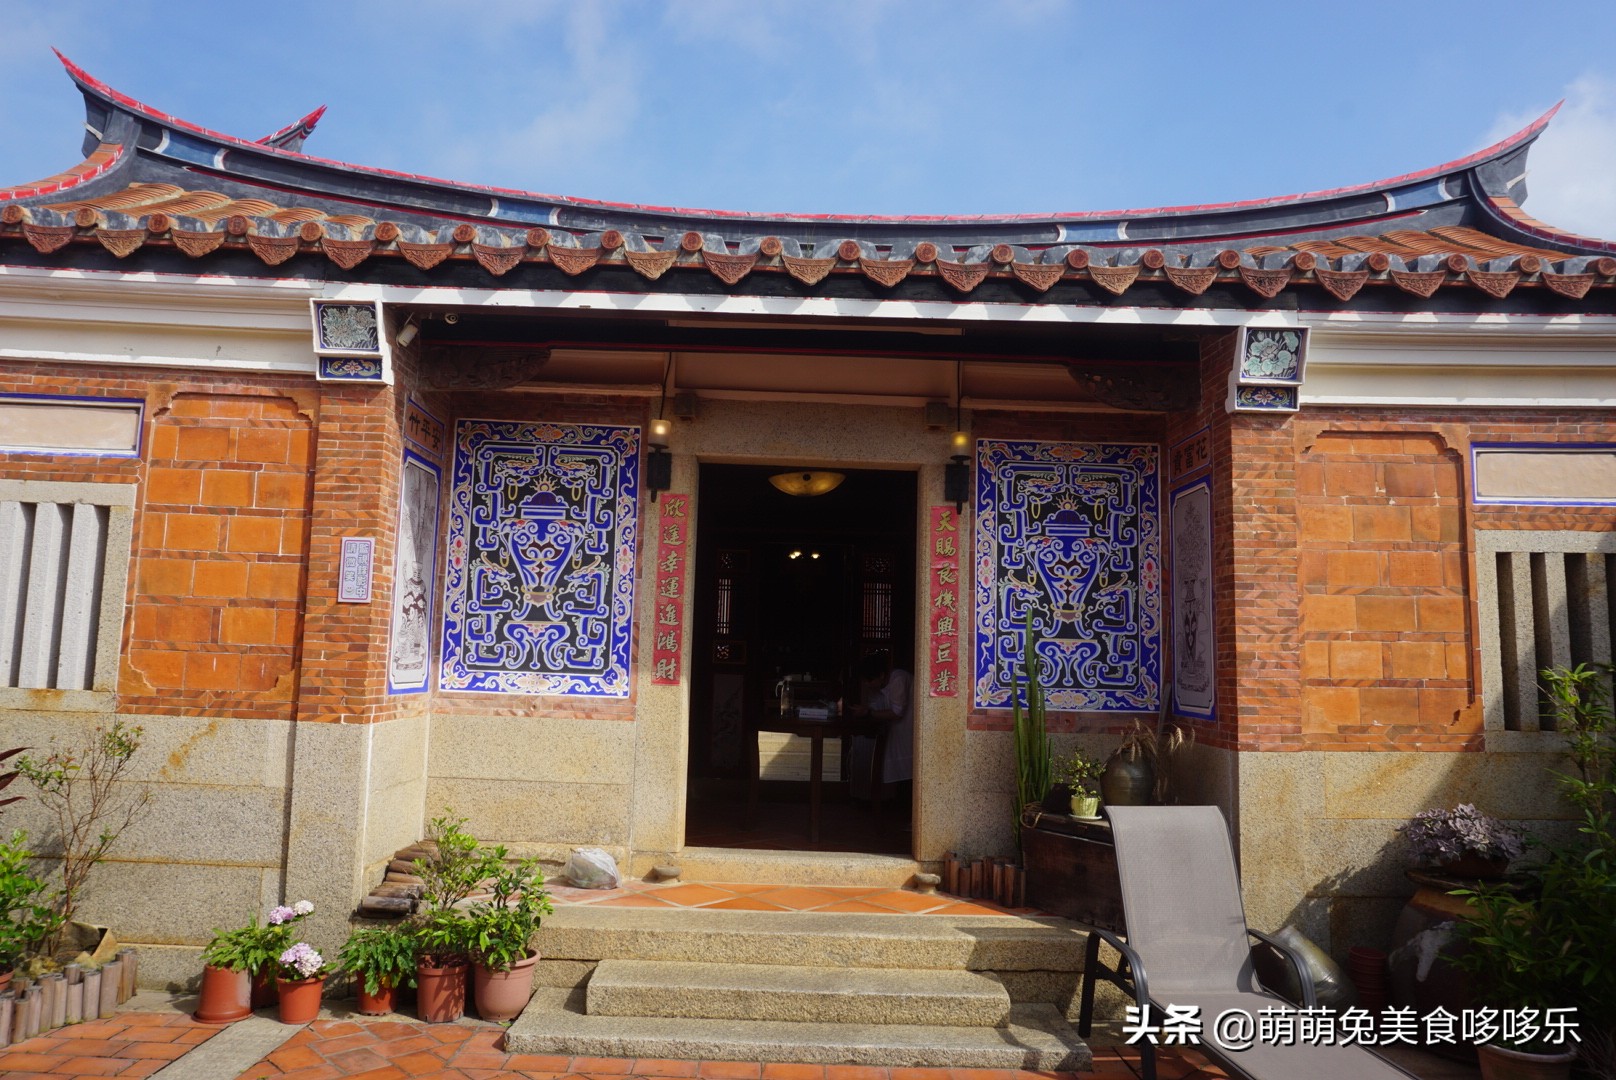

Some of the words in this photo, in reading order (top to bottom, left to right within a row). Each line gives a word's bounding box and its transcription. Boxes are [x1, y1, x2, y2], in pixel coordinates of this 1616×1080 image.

[934, 510, 957, 692] 天賜良機興巨業
